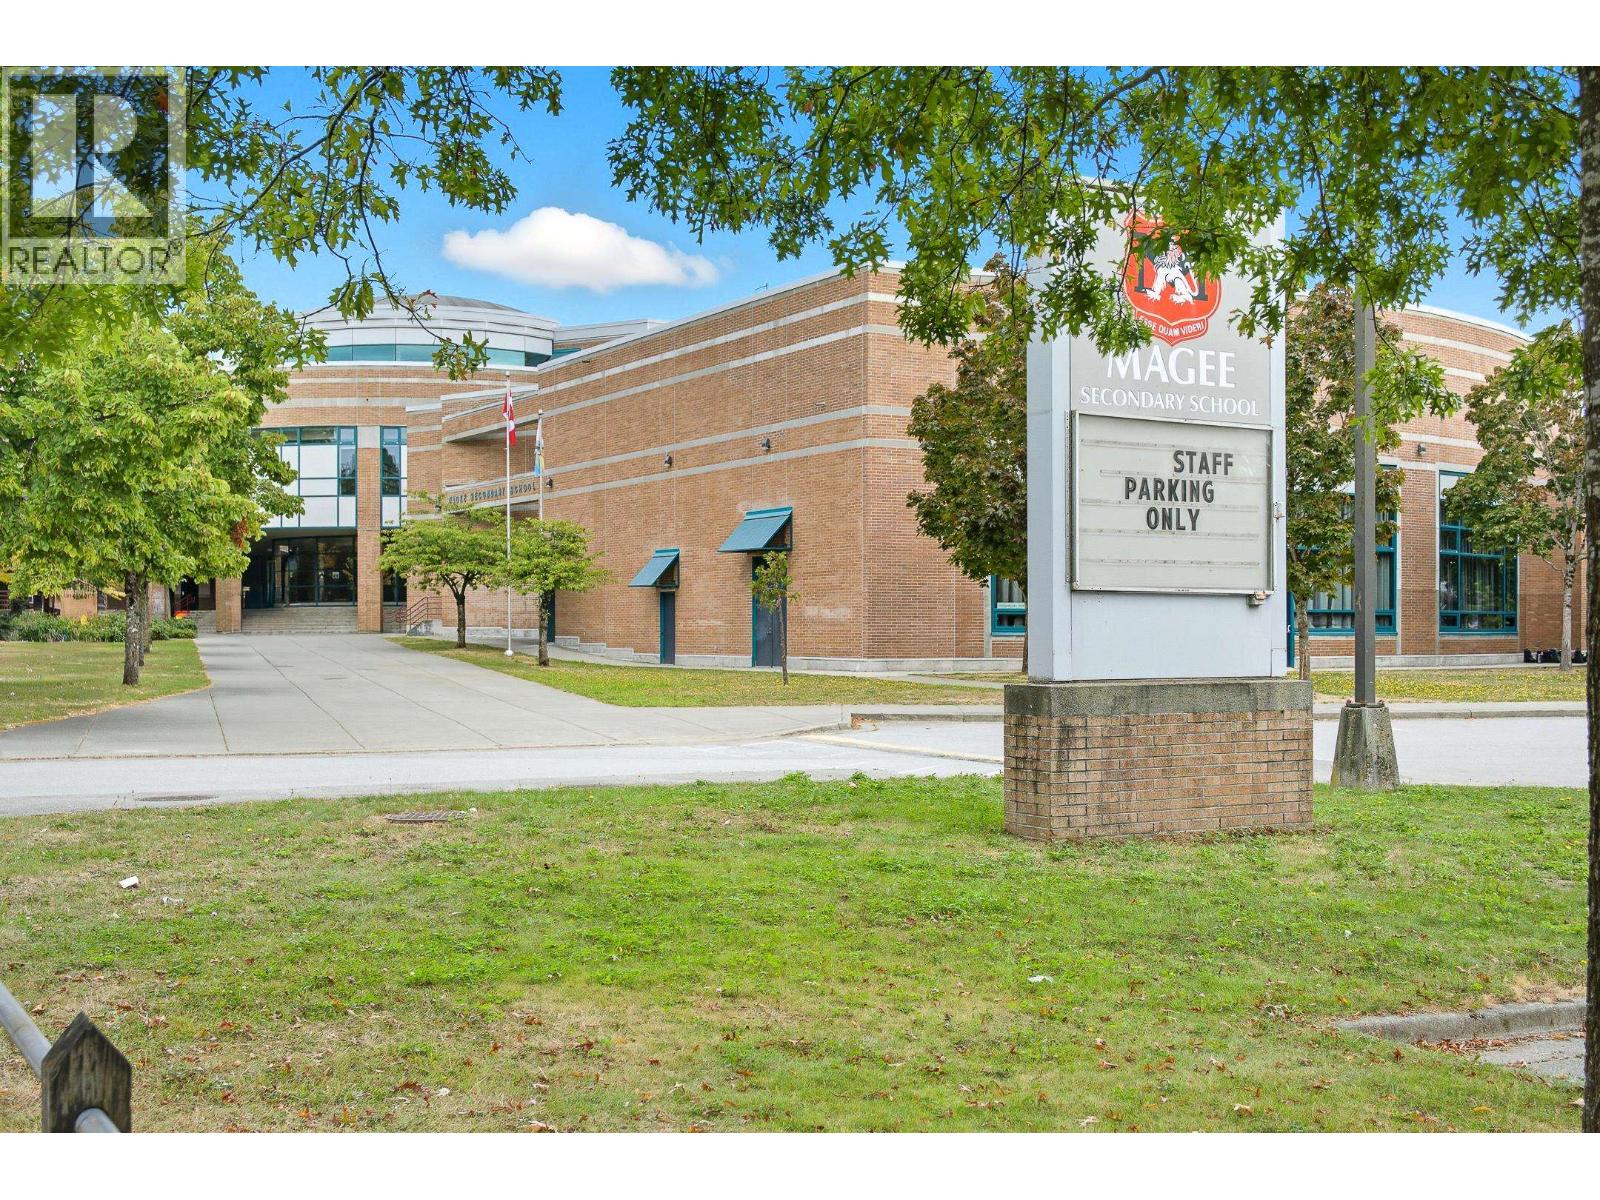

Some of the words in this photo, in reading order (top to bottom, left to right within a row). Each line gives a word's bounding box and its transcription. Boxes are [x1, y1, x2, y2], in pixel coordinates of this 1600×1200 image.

[1158, 324, 1180, 337] QUAM
[1180, 321, 1205, 335] VIDERI
[1106, 344, 1236, 388] MAGEE
[1080, 386, 1185, 411] SECONDARY
[1189, 395, 1261, 416] SCHOOL
[1173, 450, 1234, 476] STAFF
[1124, 476, 1215, 503] PARKING
[1146, 506, 1200, 531] ONLY
